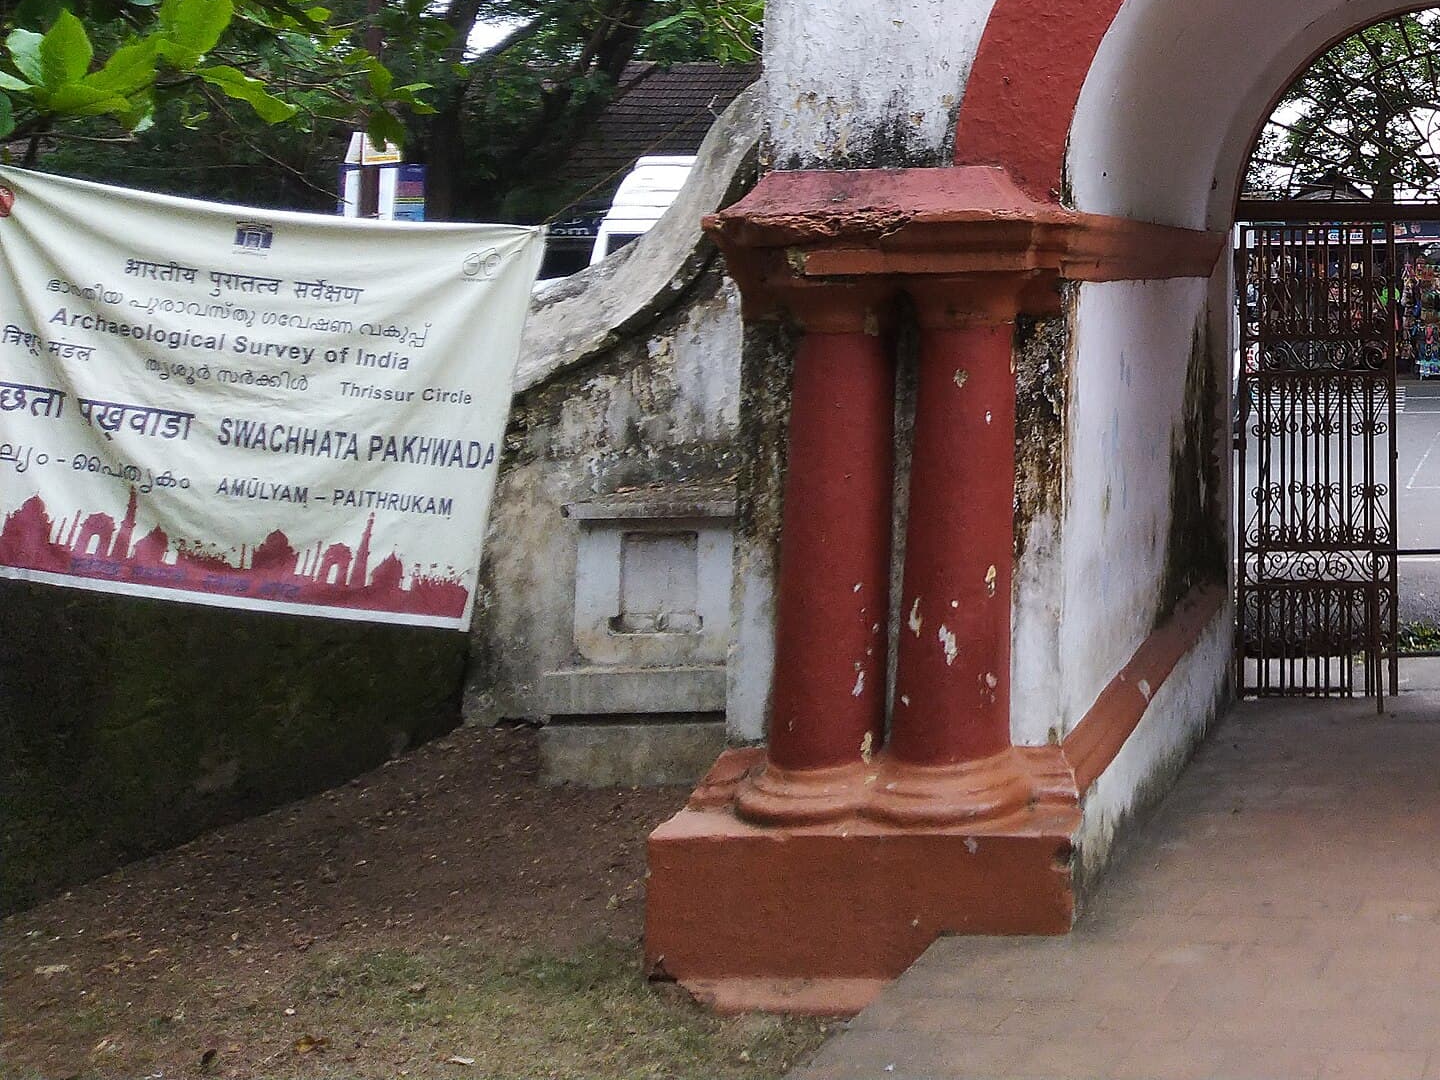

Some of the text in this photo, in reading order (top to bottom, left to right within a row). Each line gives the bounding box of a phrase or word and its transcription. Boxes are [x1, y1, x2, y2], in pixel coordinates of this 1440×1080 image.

[124, 258, 365, 305] भारतीय पुरातत्व सर्वेक्षण
[47, 337, 97, 361] मंडल
[49, 307, 410, 371] Archaeological Survey of India
[340, 381, 472, 405] Thrissur Circle
[217, 417, 495, 470] SWACHHATA PAKHWADA
